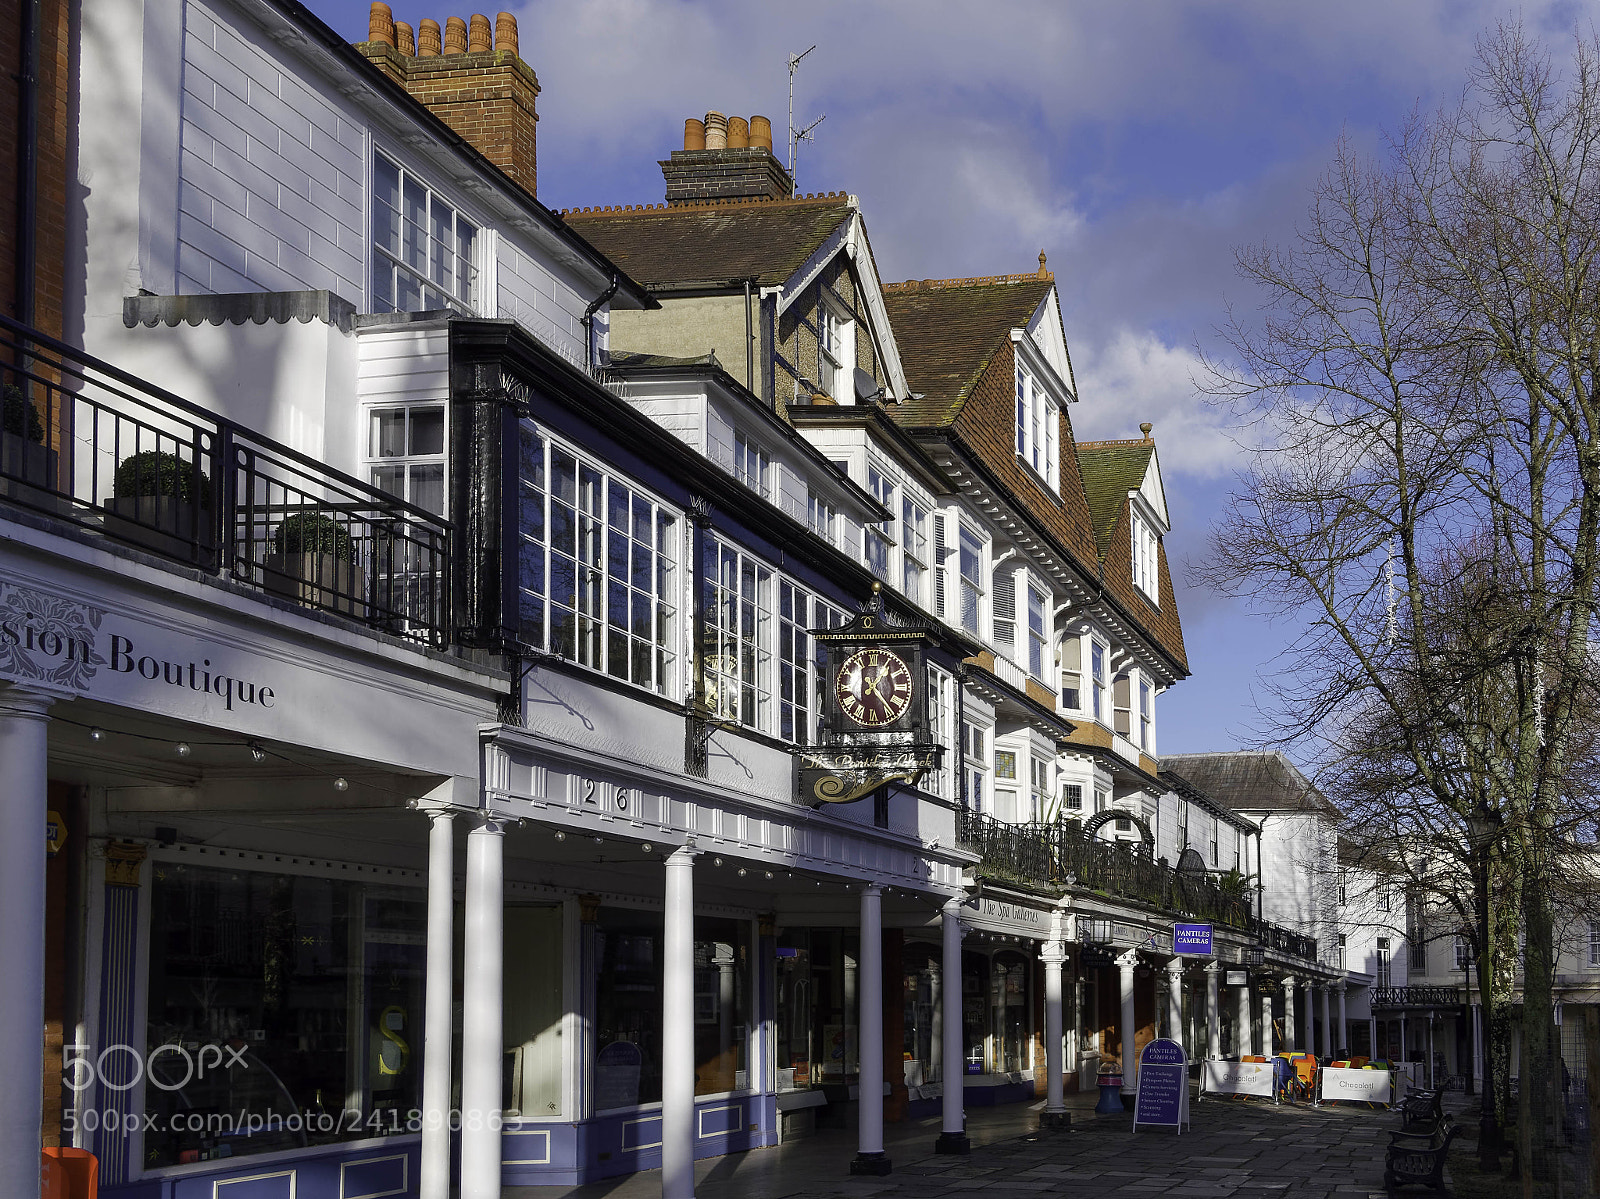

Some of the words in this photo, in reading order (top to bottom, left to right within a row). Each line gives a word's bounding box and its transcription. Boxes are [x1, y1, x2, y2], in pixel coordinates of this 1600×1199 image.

[1, 611, 92, 665] sion
[107, 633, 275, 711] Boutique
[998, 901, 1010, 920] Spa
[1177, 930, 1210, 938] PANTILES
[1177, 937, 1209, 945] CAMERAS
[1149, 1047, 1178, 1055] PANTILES
